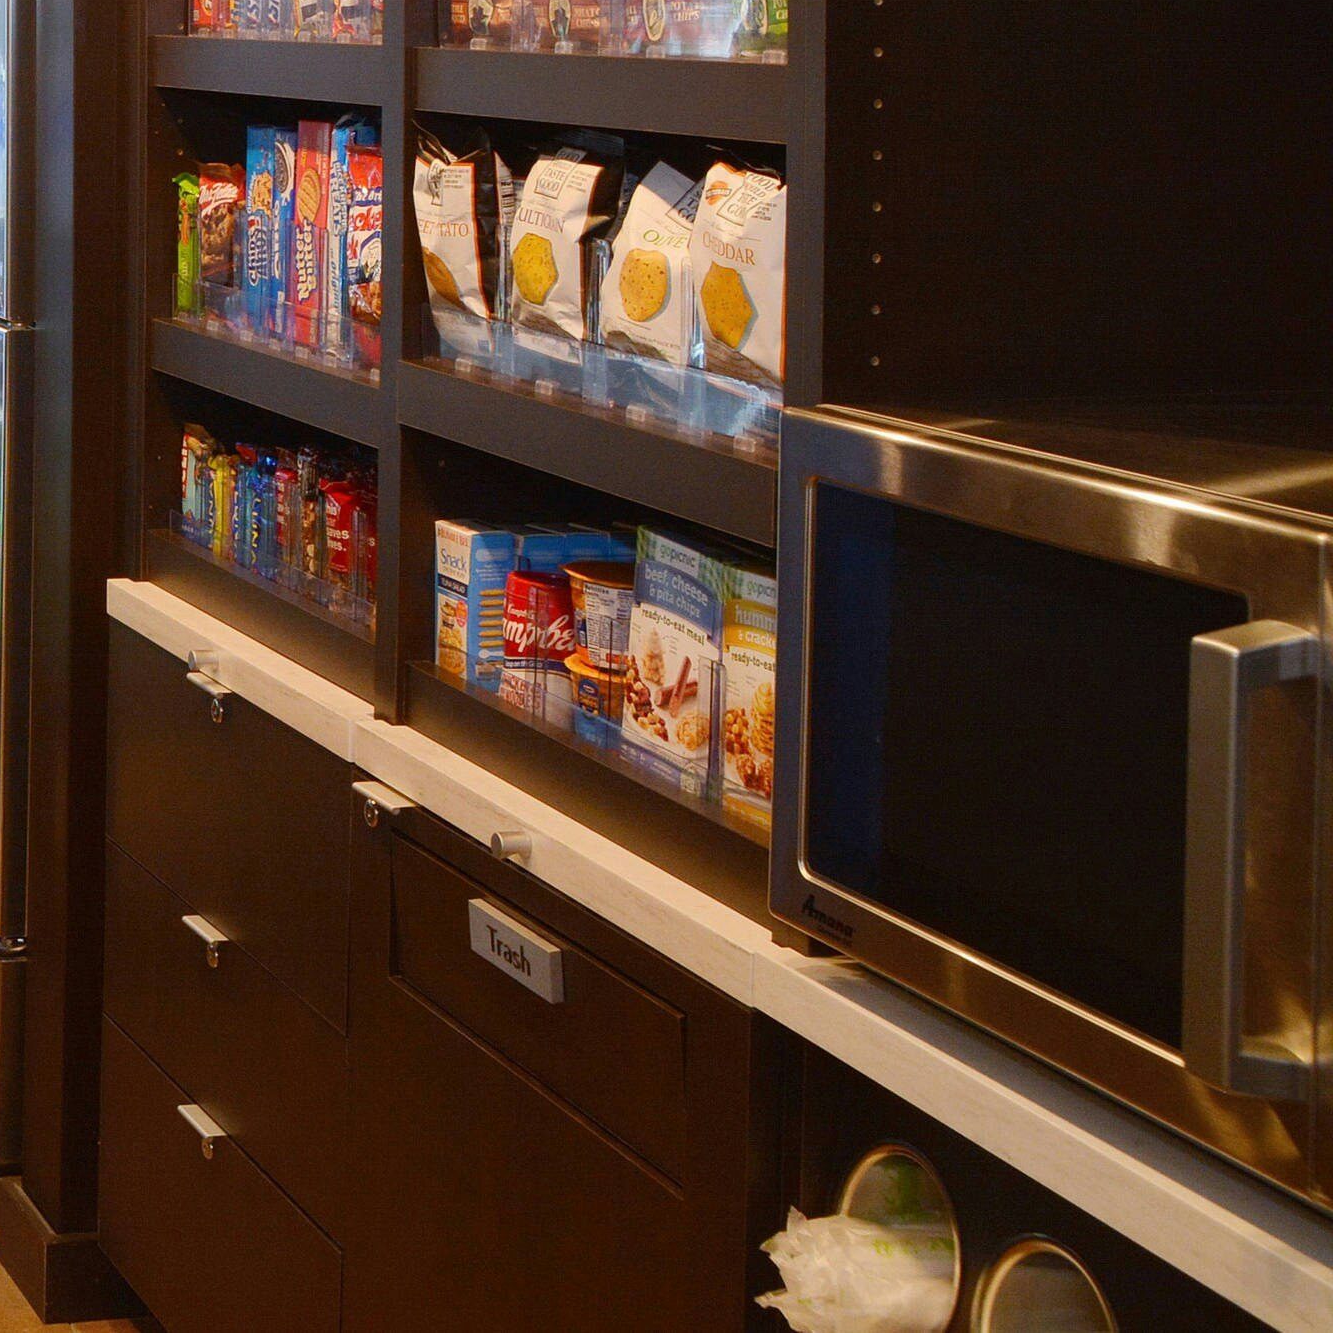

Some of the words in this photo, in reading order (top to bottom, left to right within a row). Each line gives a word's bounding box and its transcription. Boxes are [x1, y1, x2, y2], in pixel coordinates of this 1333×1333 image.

[539, 178, 561, 193] GOOD
[438, 222, 470, 238] TATO
[643, 229, 688, 249] OLIVE
[702, 230, 757, 266] CHEDDAR
[440, 547, 467, 573] Snack
[660, 544, 696, 568] gopicnic
[644, 564, 669, 587] beef,
[671, 574, 709, 607] cheese
[641, 607, 686, 634] ready-to-eat
[686, 627, 706, 647] meal
[735, 603, 776, 632] humm
[731, 651, 775, 672] ready-to-ea
[802, 894, 854, 938] Amana
[486, 924, 532, 978] Trash
